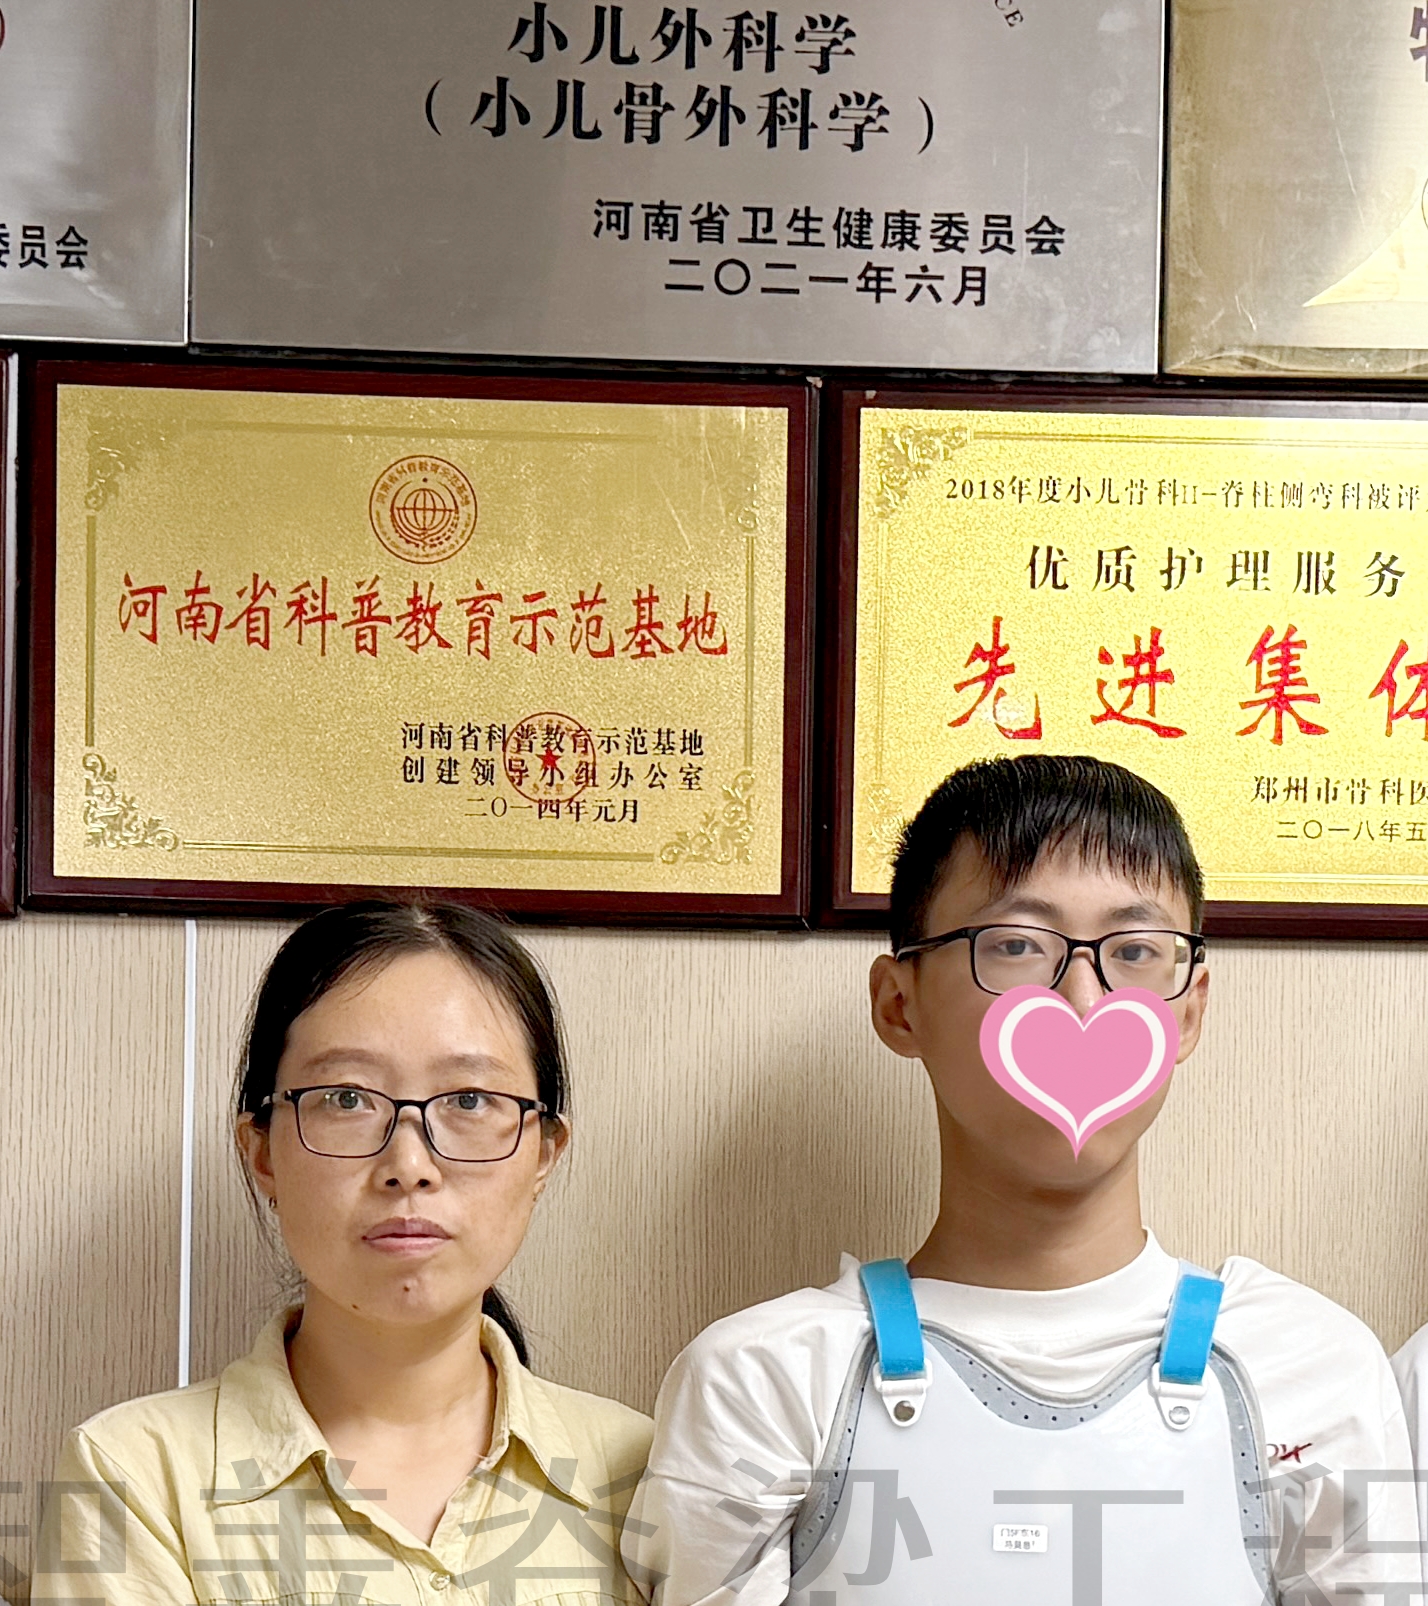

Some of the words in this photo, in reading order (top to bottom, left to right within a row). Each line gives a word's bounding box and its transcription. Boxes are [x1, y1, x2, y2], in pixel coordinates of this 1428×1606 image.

[507, 1, 858, 75] 小儿外科学
[424, 76, 936, 155] （小儿骨外科学）
[592, 198, 1066, 257] 河南省卫生健康委员会
[1026, 544, 1406, 599] 优质护理服务
[118, 568, 728, 660] 河南省科普教育示范基地
[401, 722, 705, 757] 河南省科普教育示范基地
[401, 756, 704, 792] 创建领导小组办公室
